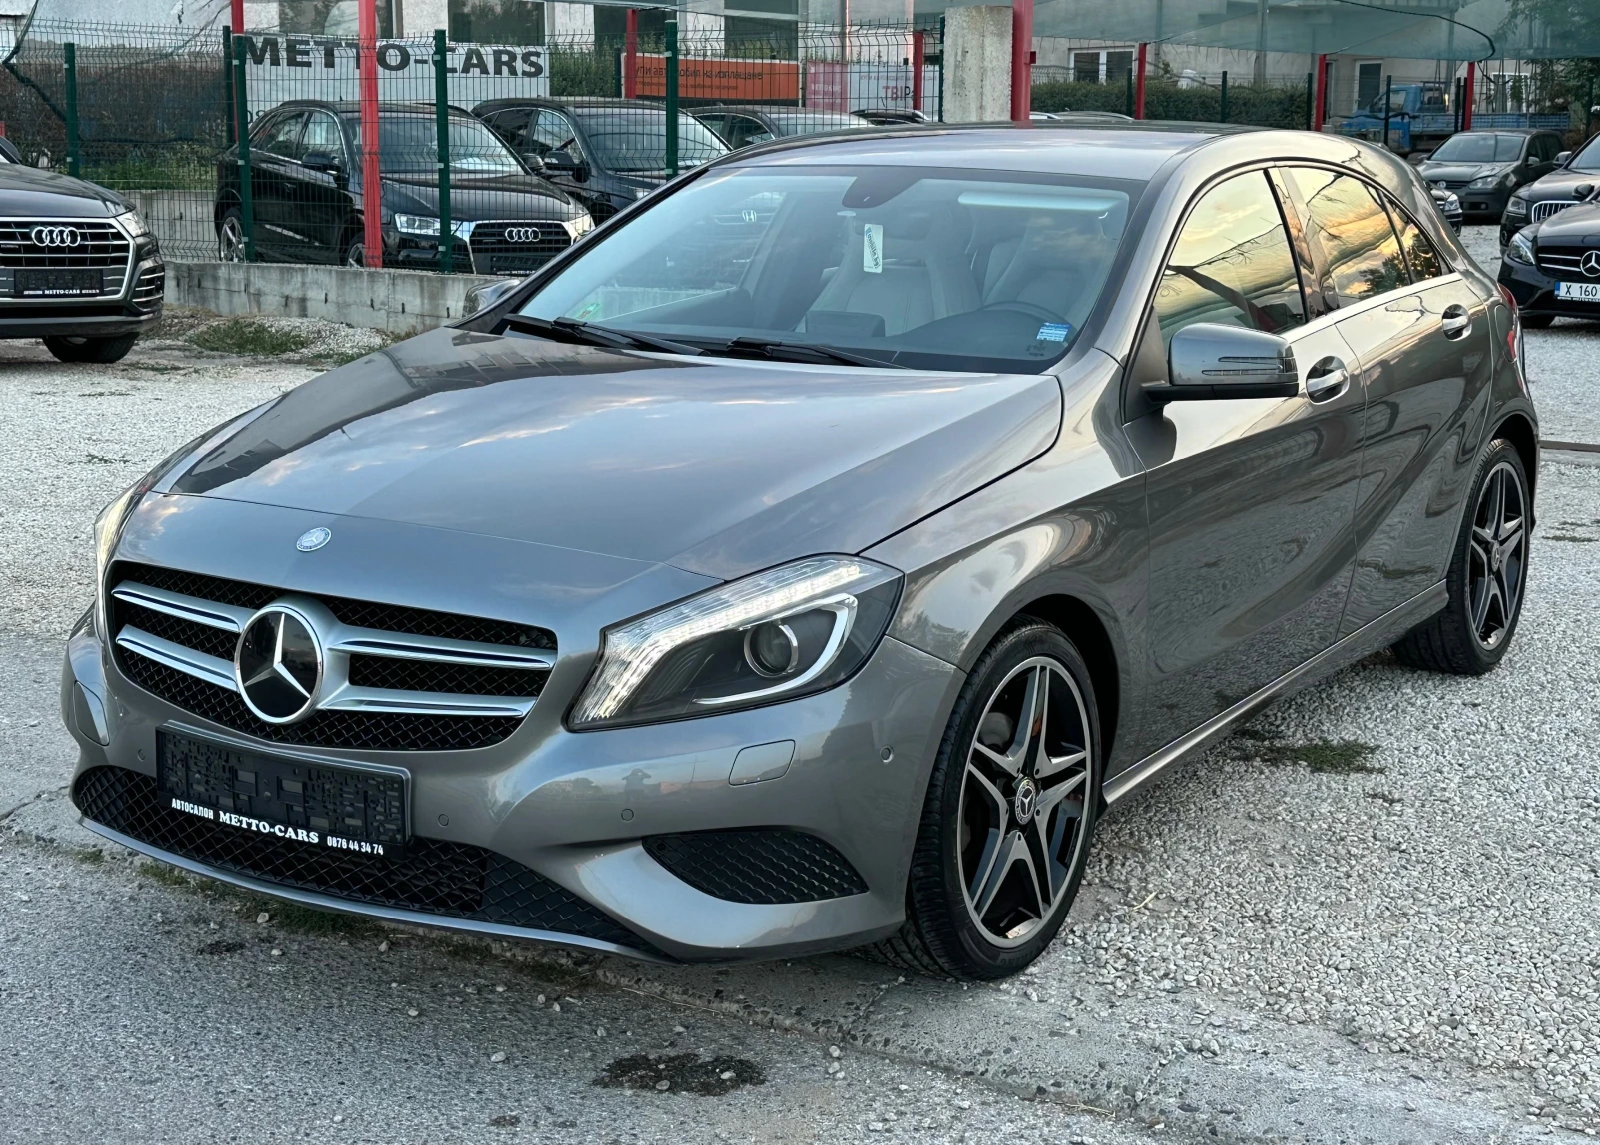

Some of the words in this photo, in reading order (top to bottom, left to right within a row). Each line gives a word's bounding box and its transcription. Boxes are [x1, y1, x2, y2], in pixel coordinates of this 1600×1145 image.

[1579, 285, 1600, 297] 160
[171, 798, 214, 819] АВТОСАЛОН
[219, 811, 319, 843] METTO-CARS
[326, 836, 347, 849] 0876
[348, 840, 359, 851] 44
[361, 842, 371, 853] 34
[373, 844, 384, 855] 74
